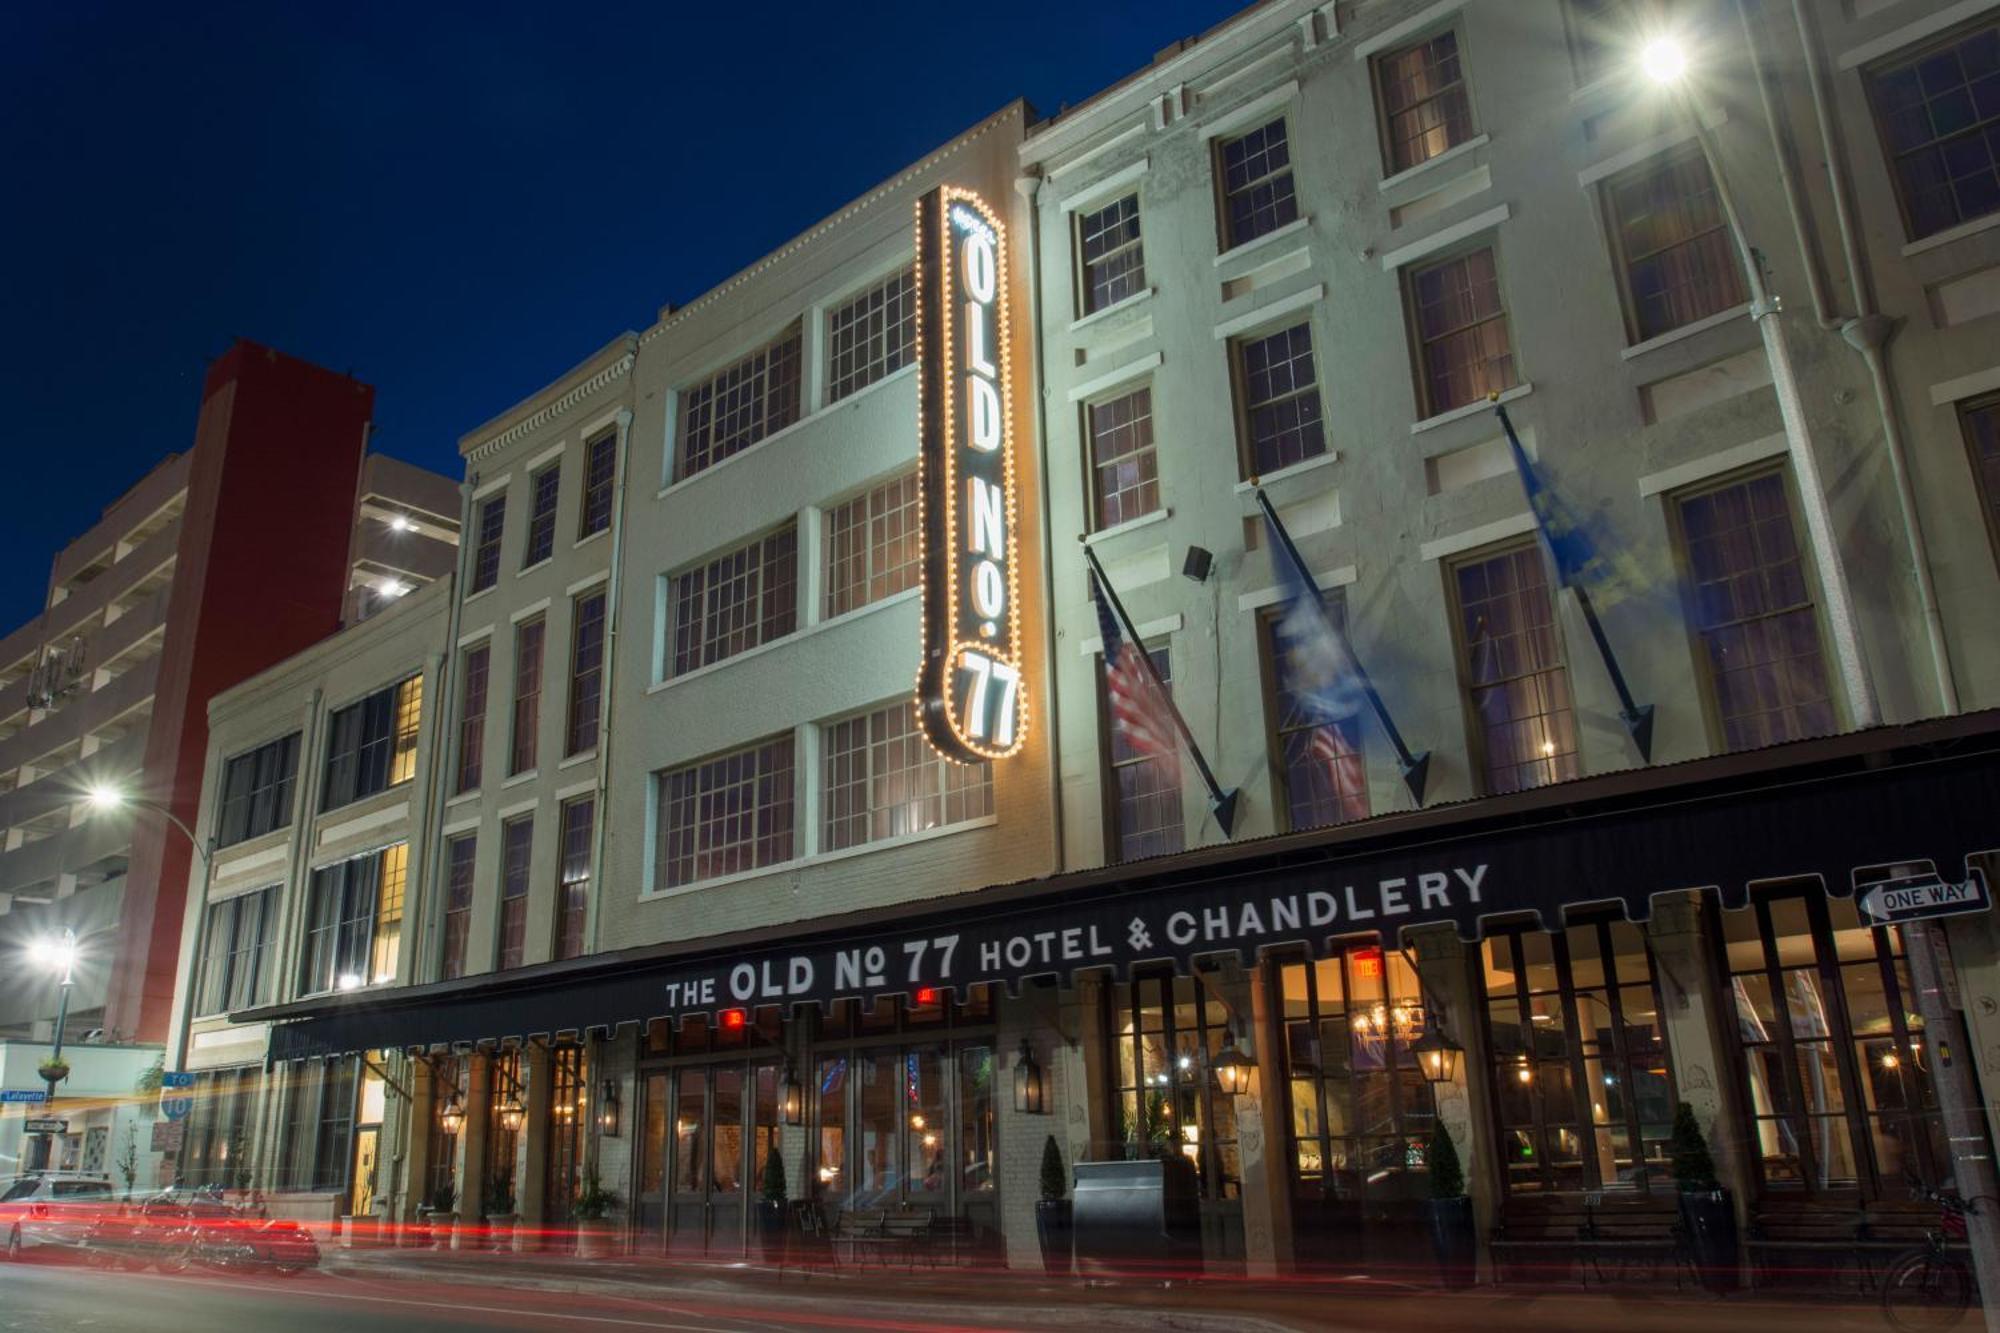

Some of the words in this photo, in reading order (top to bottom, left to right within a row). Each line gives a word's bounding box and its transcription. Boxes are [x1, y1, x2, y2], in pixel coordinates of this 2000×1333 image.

[962, 234, 1000, 453] OLD
[958, 650, 1019, 747] 77
[1884, 889, 1924, 909] ONE
[1928, 884, 1968, 903] WAY
[666, 978, 716, 1008] THE
[729, 956, 814, 1000] OLD
[903, 934, 959, 982] 77
[980, 927, 1112, 972] HOTEL
[1127, 917, 1155, 951] &
[1167, 864, 1488, 945] CHANDLERY
[172, 1074, 188, 1085] TO
[6, 1090, 44, 1102] Lafayette
[167, 1097, 187, 1114] 10
